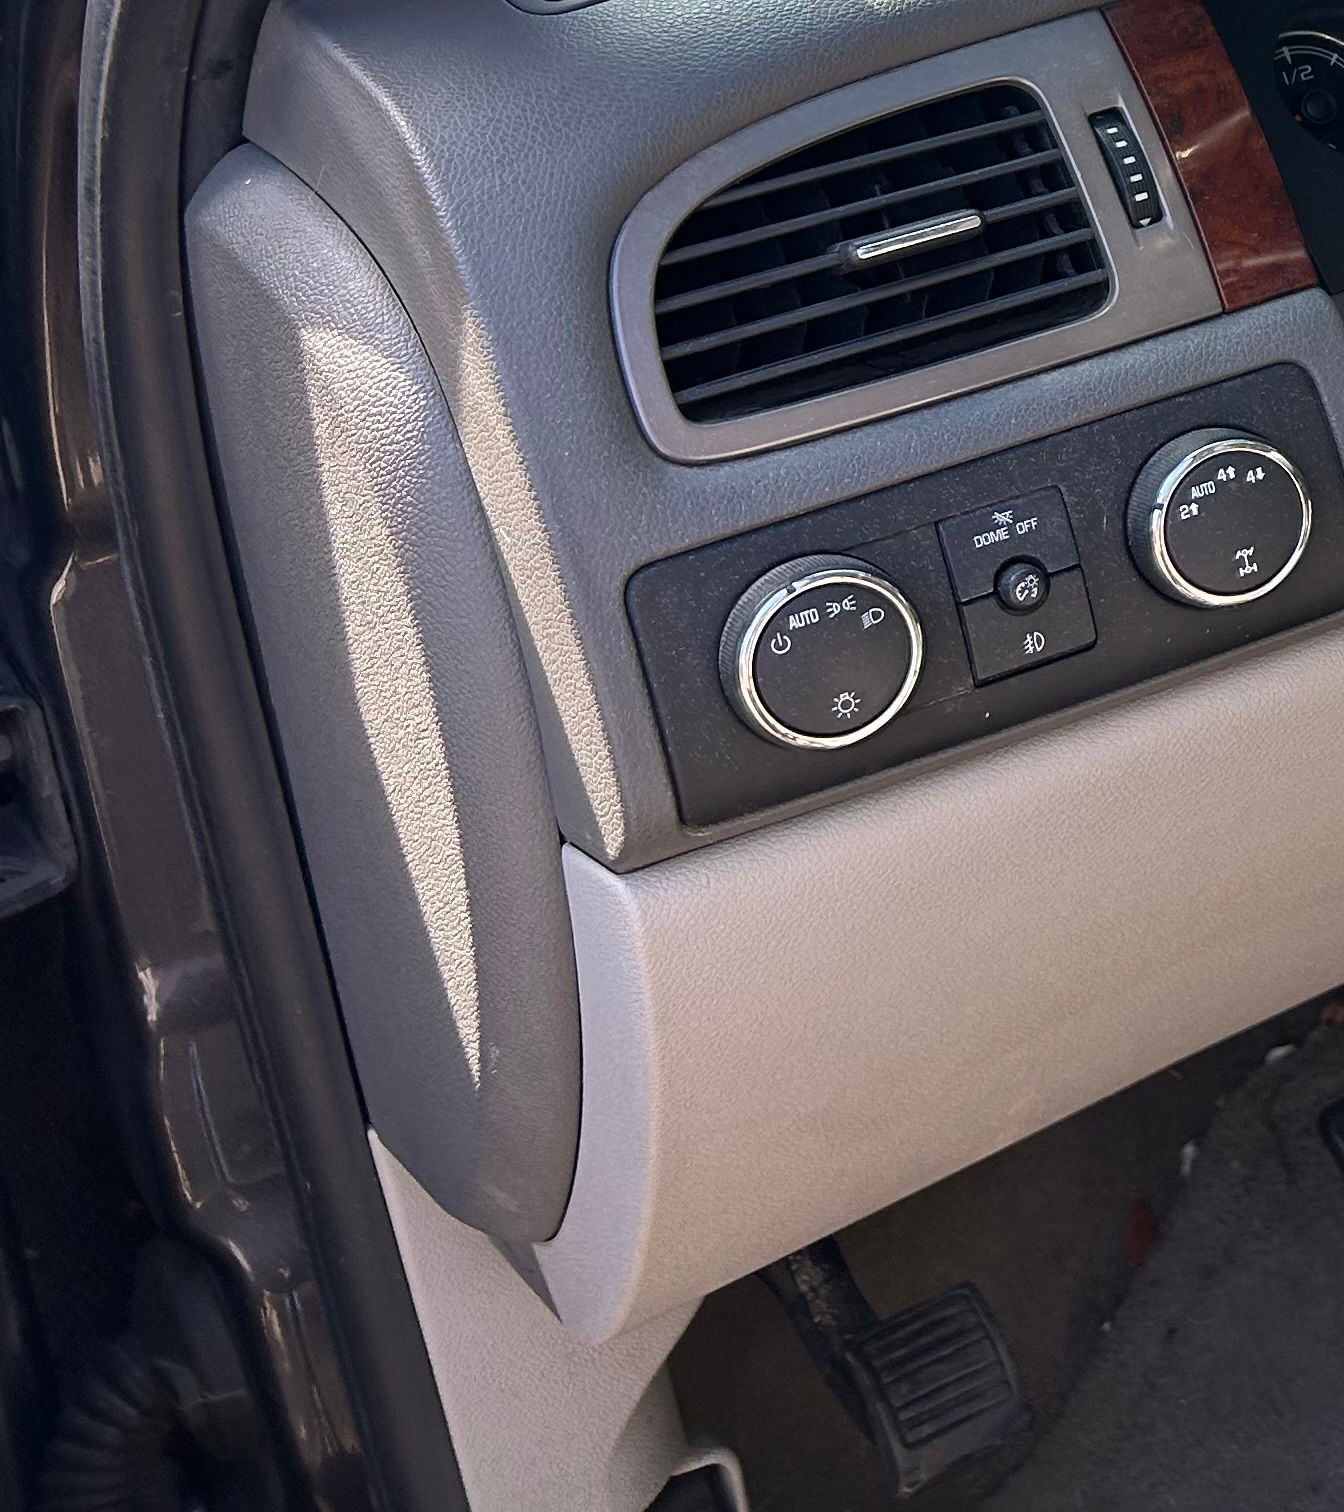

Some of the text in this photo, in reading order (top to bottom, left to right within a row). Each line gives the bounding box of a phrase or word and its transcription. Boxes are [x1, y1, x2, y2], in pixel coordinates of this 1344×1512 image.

[1282, 65, 1315, 86] 1/2
[1217, 468, 1227, 482] 4
[1246, 470, 1256, 484] 4
[1191, 481, 1216, 500] AUTO
[1180, 504, 1190, 520] 2
[973, 517, 1038, 549] DOME OFF
[788, 608, 820, 630] AUTO
